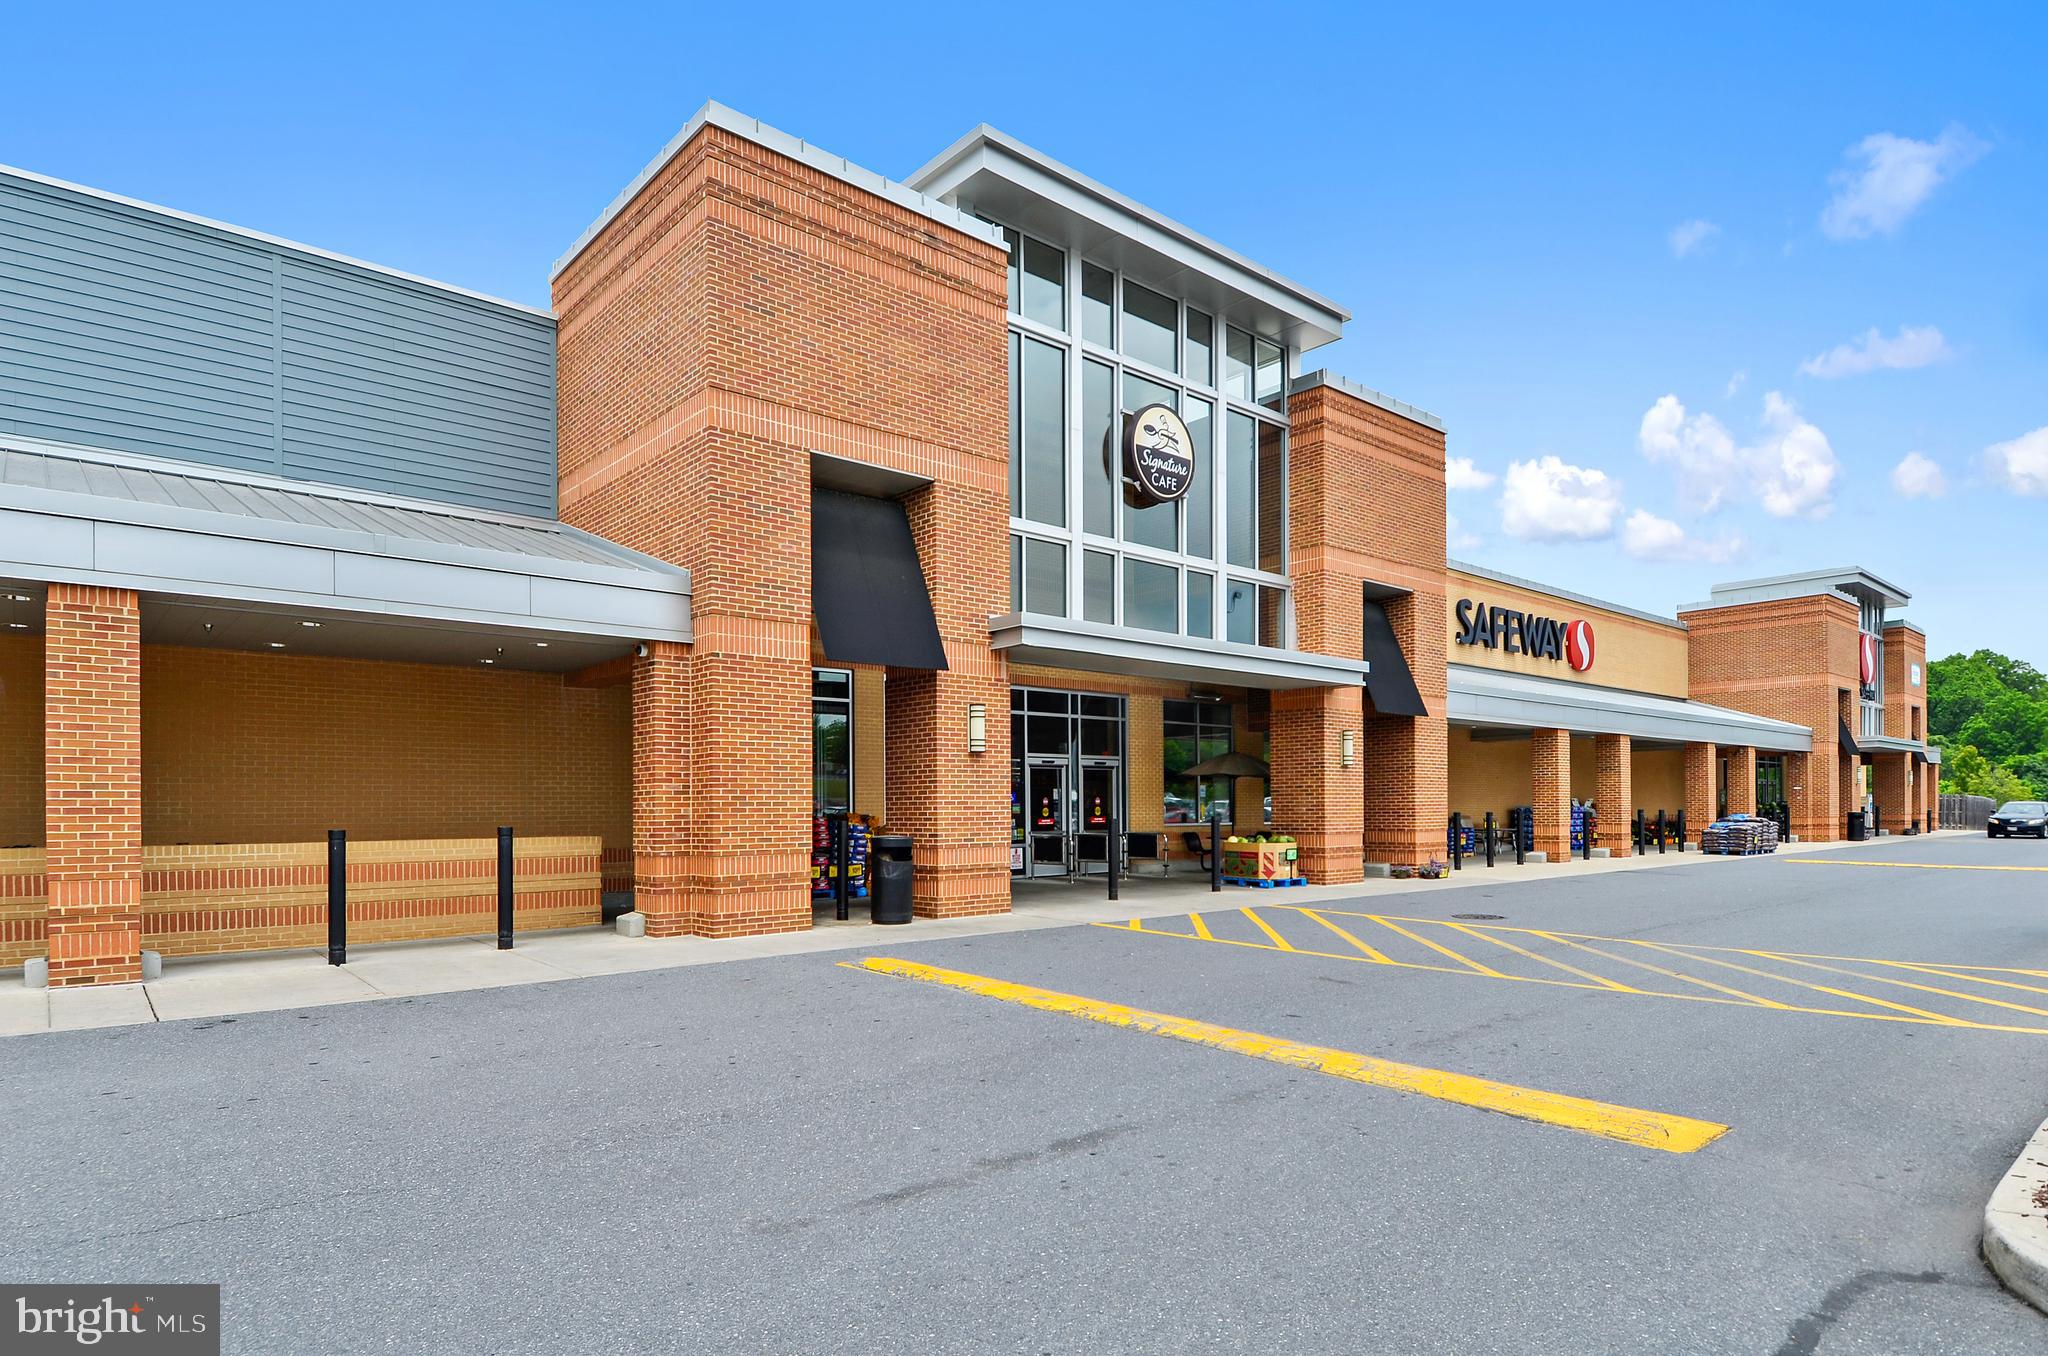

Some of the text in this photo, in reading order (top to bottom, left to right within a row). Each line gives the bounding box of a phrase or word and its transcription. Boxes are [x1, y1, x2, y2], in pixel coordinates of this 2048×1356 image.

[1140, 449, 1188, 476] Signature
[1151, 473, 1178, 491] CAFE
[1455, 598, 1569, 661] SAFEWAY
